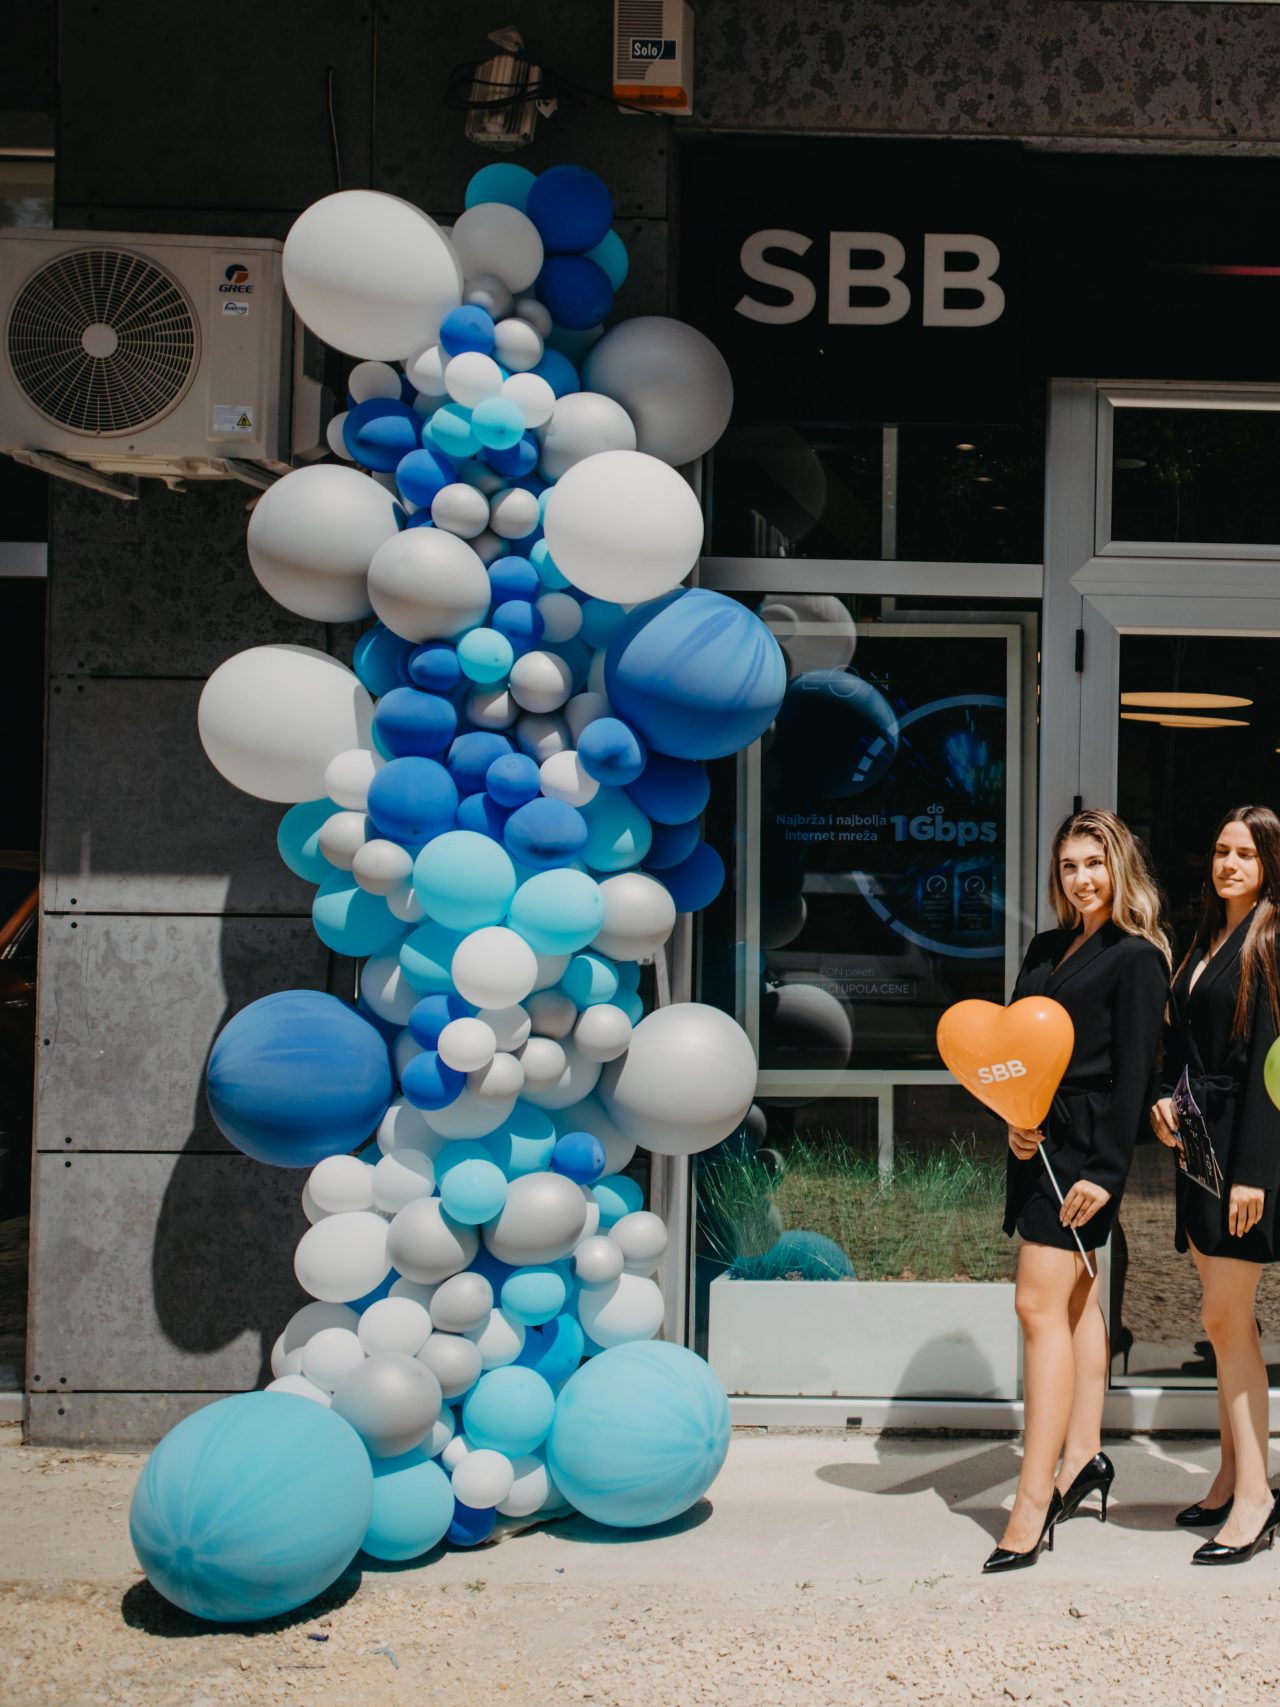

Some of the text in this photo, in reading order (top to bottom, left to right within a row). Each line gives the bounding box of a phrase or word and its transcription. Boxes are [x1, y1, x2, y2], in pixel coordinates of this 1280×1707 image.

[633, 42, 658, 56] Solo
[734, 228, 1006, 327] SBB
[218, 284, 254, 294] GREE
[926, 803, 945, 815] do
[776, 814, 887, 828] Najbrža i najbolja
[785, 829, 878, 842] internet mreža
[889, 814, 998, 847] 1Gbps
[845, 967, 875, 979] paketi
[841, 984, 878, 994] UPOLA
[880, 983, 909, 994] CENE
[977, 1059, 1027, 1084] SBB
